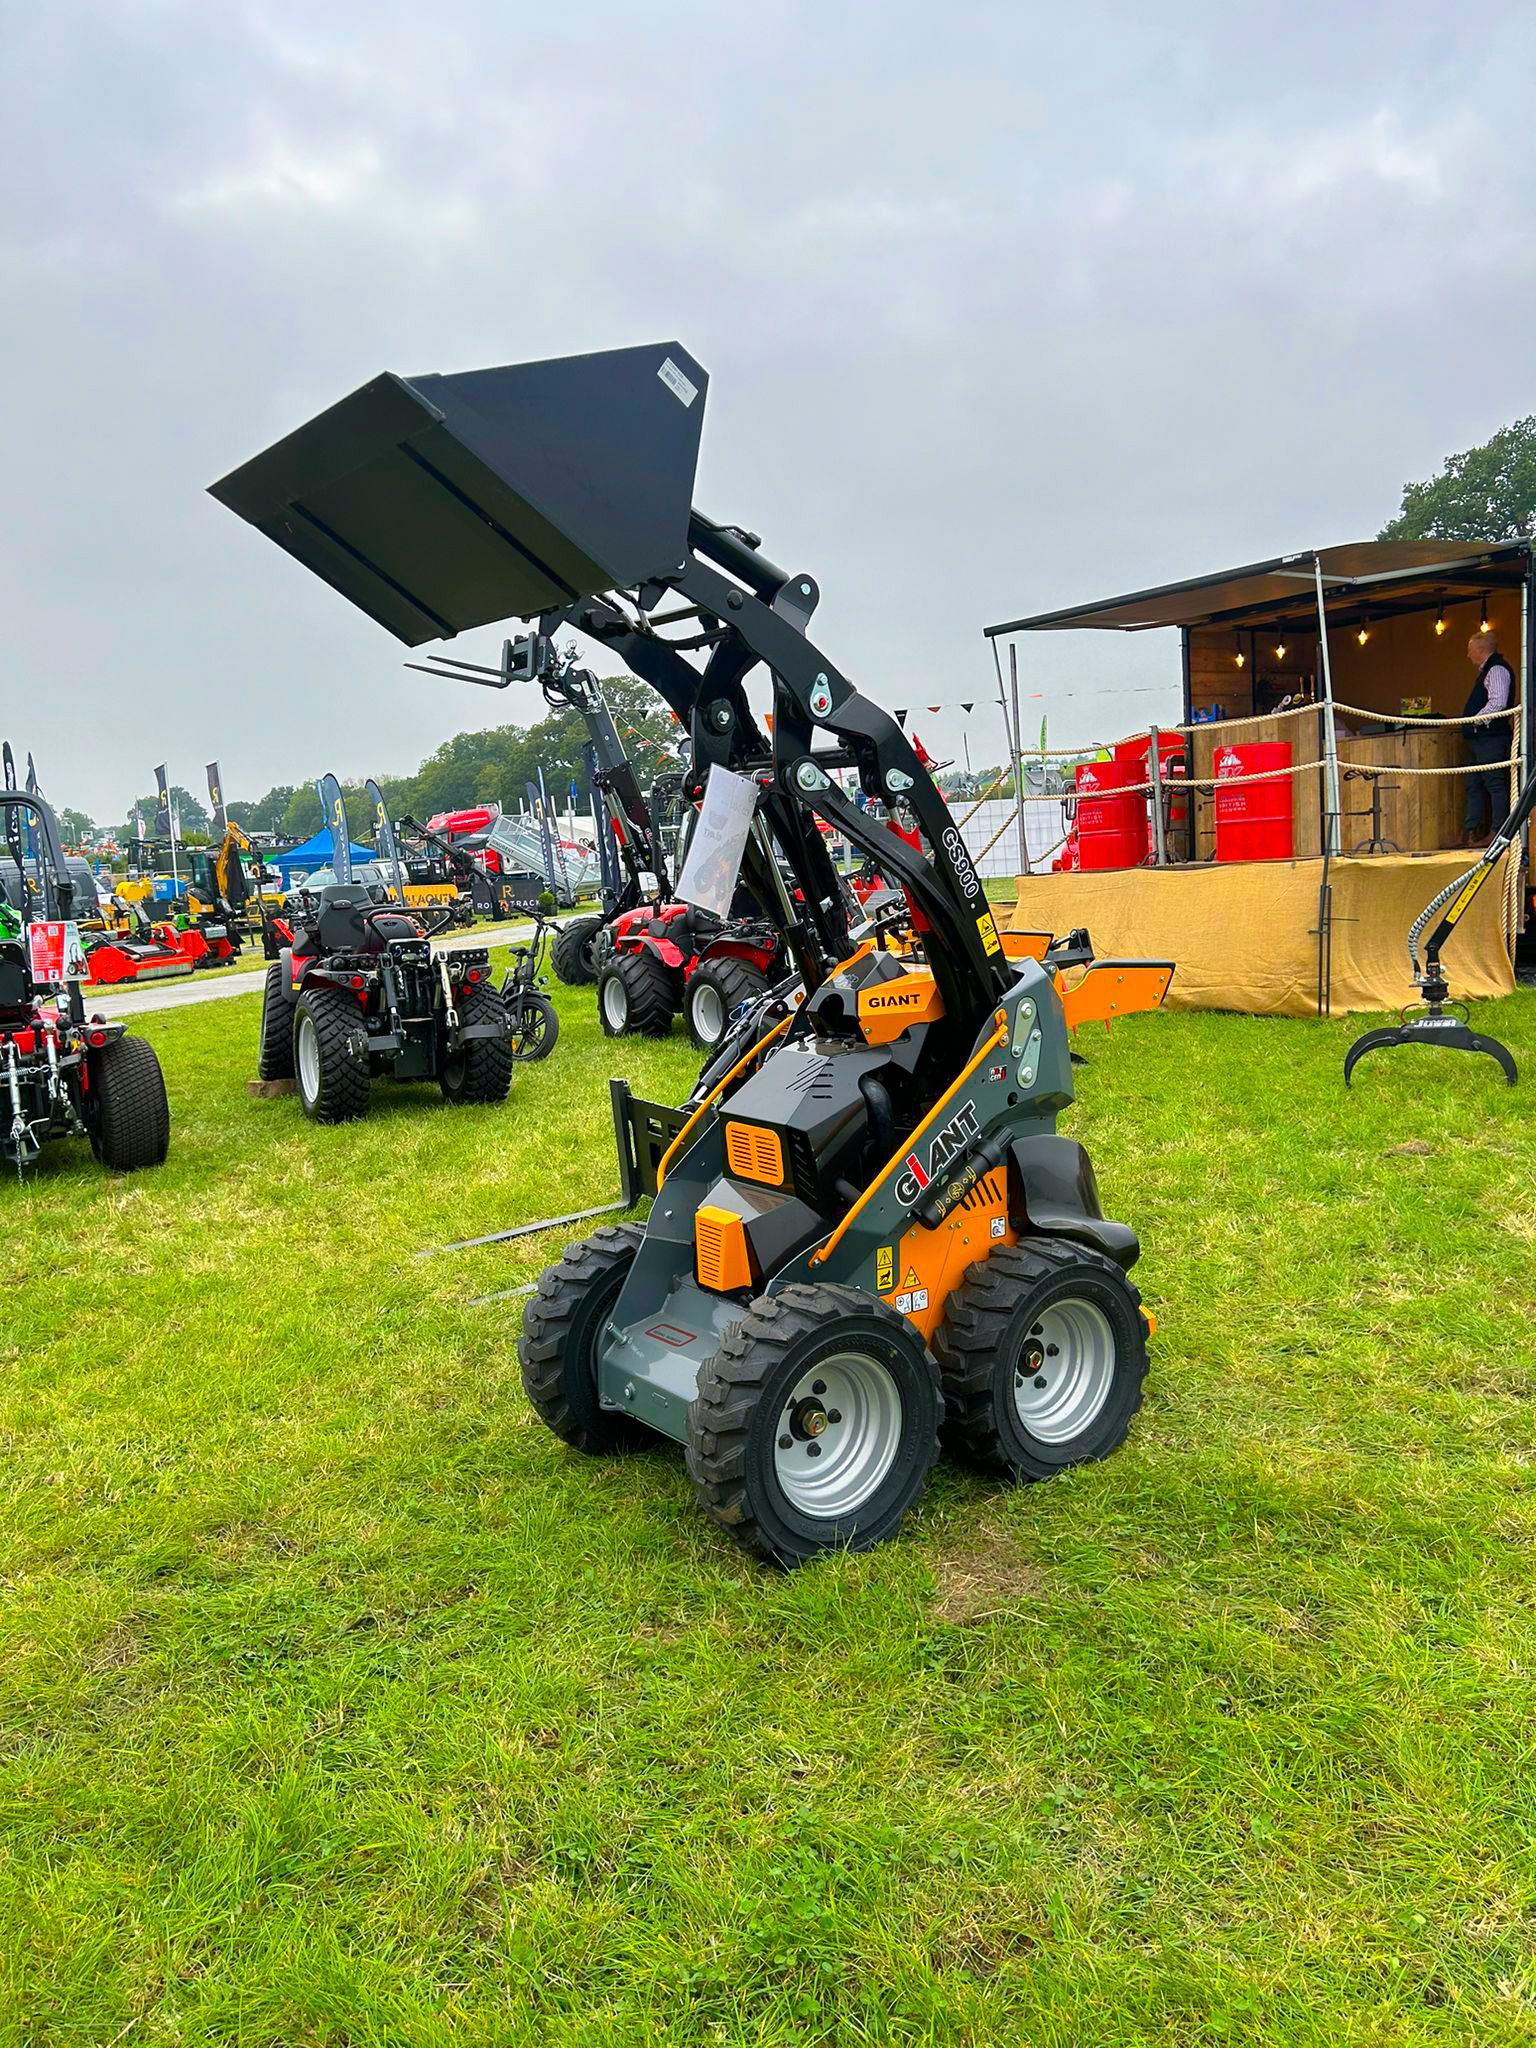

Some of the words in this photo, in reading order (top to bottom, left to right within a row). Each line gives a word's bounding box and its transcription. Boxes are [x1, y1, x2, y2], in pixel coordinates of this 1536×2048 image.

[942, 826, 980, 899] GS900
[502, 884, 515, 898] R
[868, 993, 921, 1009] GIANT
[895, 1098, 983, 1206] GIANT
